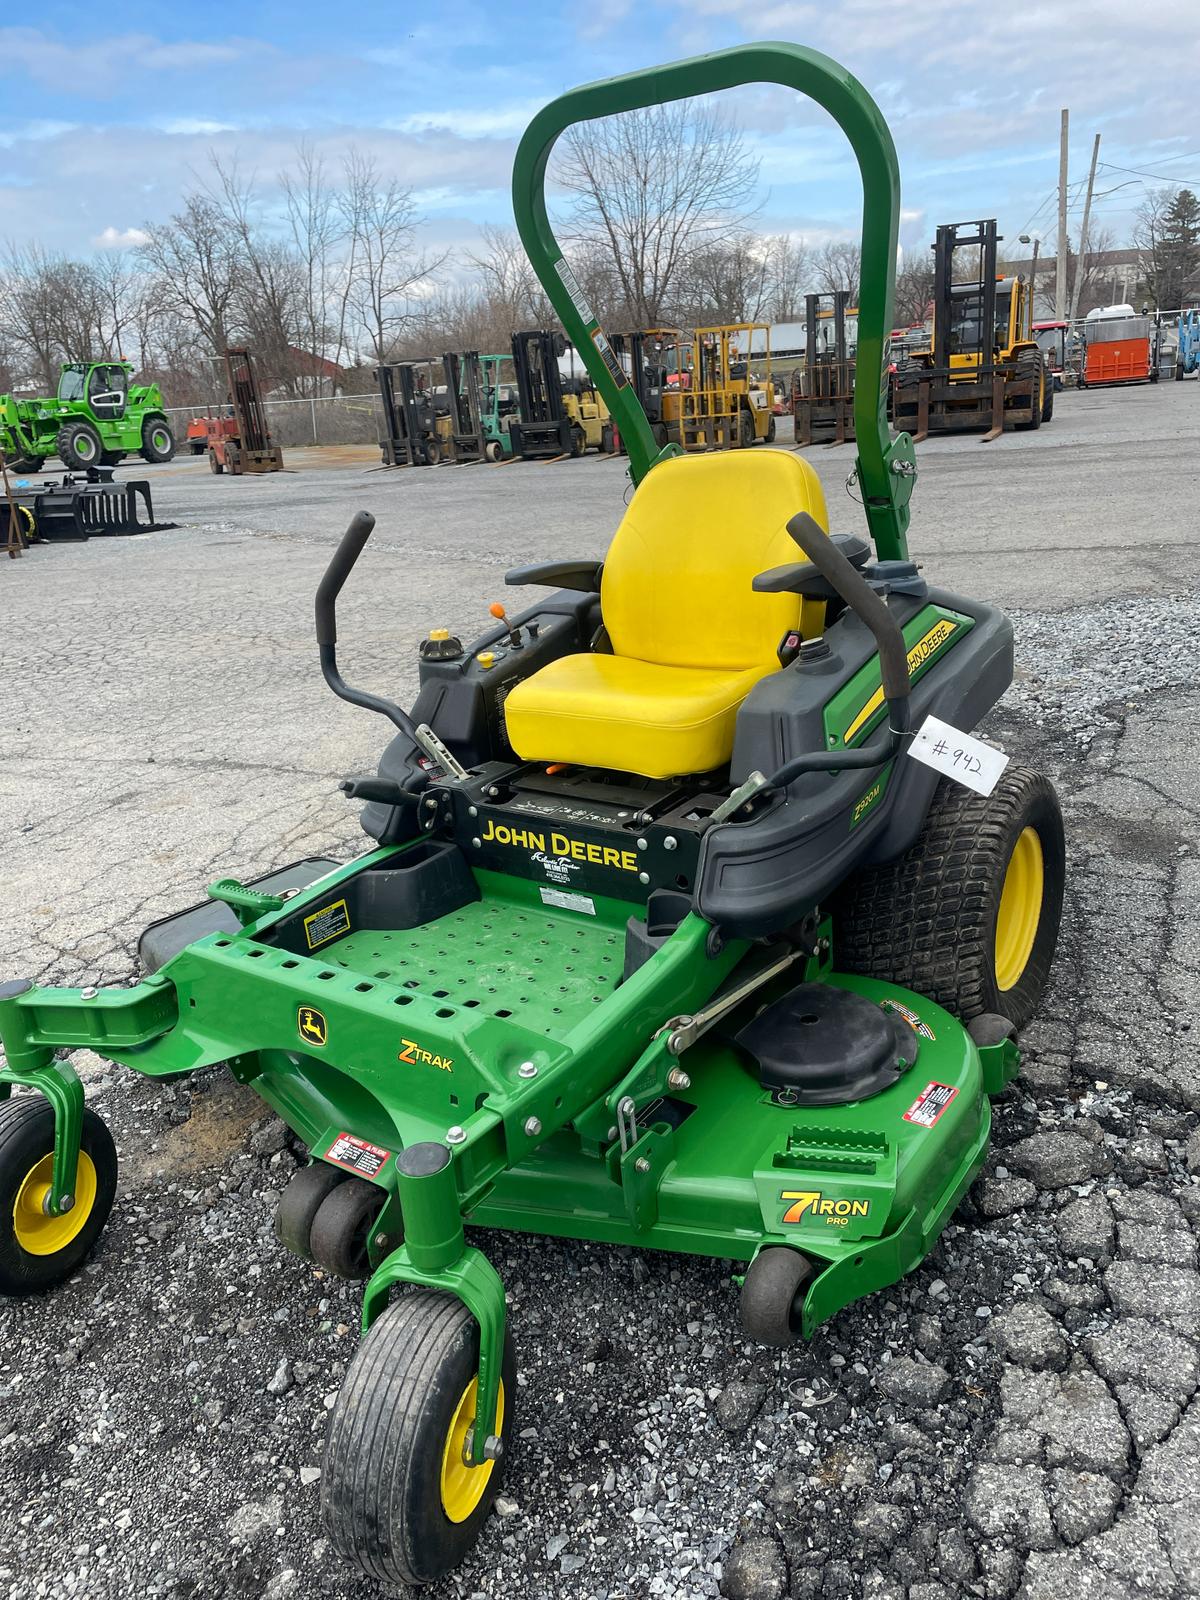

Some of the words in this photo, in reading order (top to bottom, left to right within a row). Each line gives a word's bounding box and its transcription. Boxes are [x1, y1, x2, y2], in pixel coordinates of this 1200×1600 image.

[920, 625, 949, 659] DEERE
[482, 820, 545, 851] JOHN
[551, 832, 638, 871] DEERE
[826, 1217, 849, 1225] PRO
